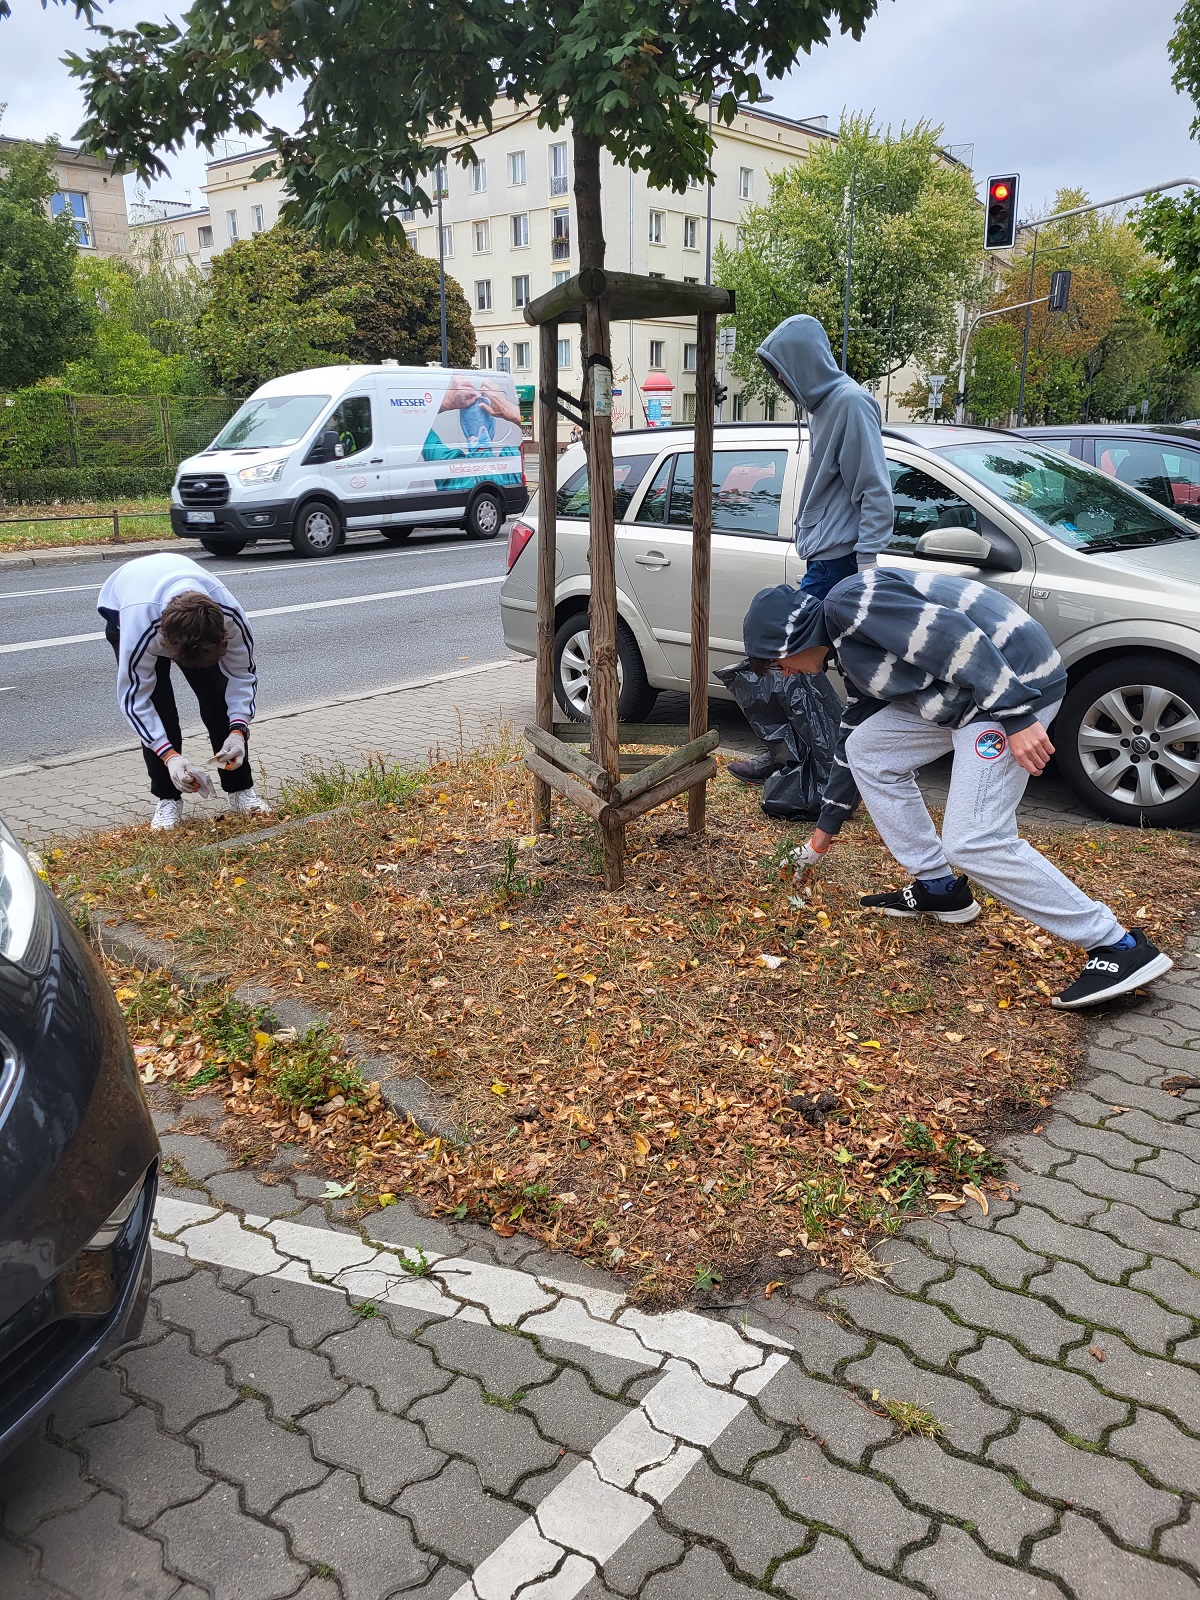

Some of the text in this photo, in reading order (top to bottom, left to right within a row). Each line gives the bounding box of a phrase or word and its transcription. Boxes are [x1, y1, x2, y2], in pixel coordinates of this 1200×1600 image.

[390, 398, 426, 407] MESSER
[449, 463, 471, 474] Medical
[472, 464, 488, 474] gases
[496, 463, 508, 471] tour
